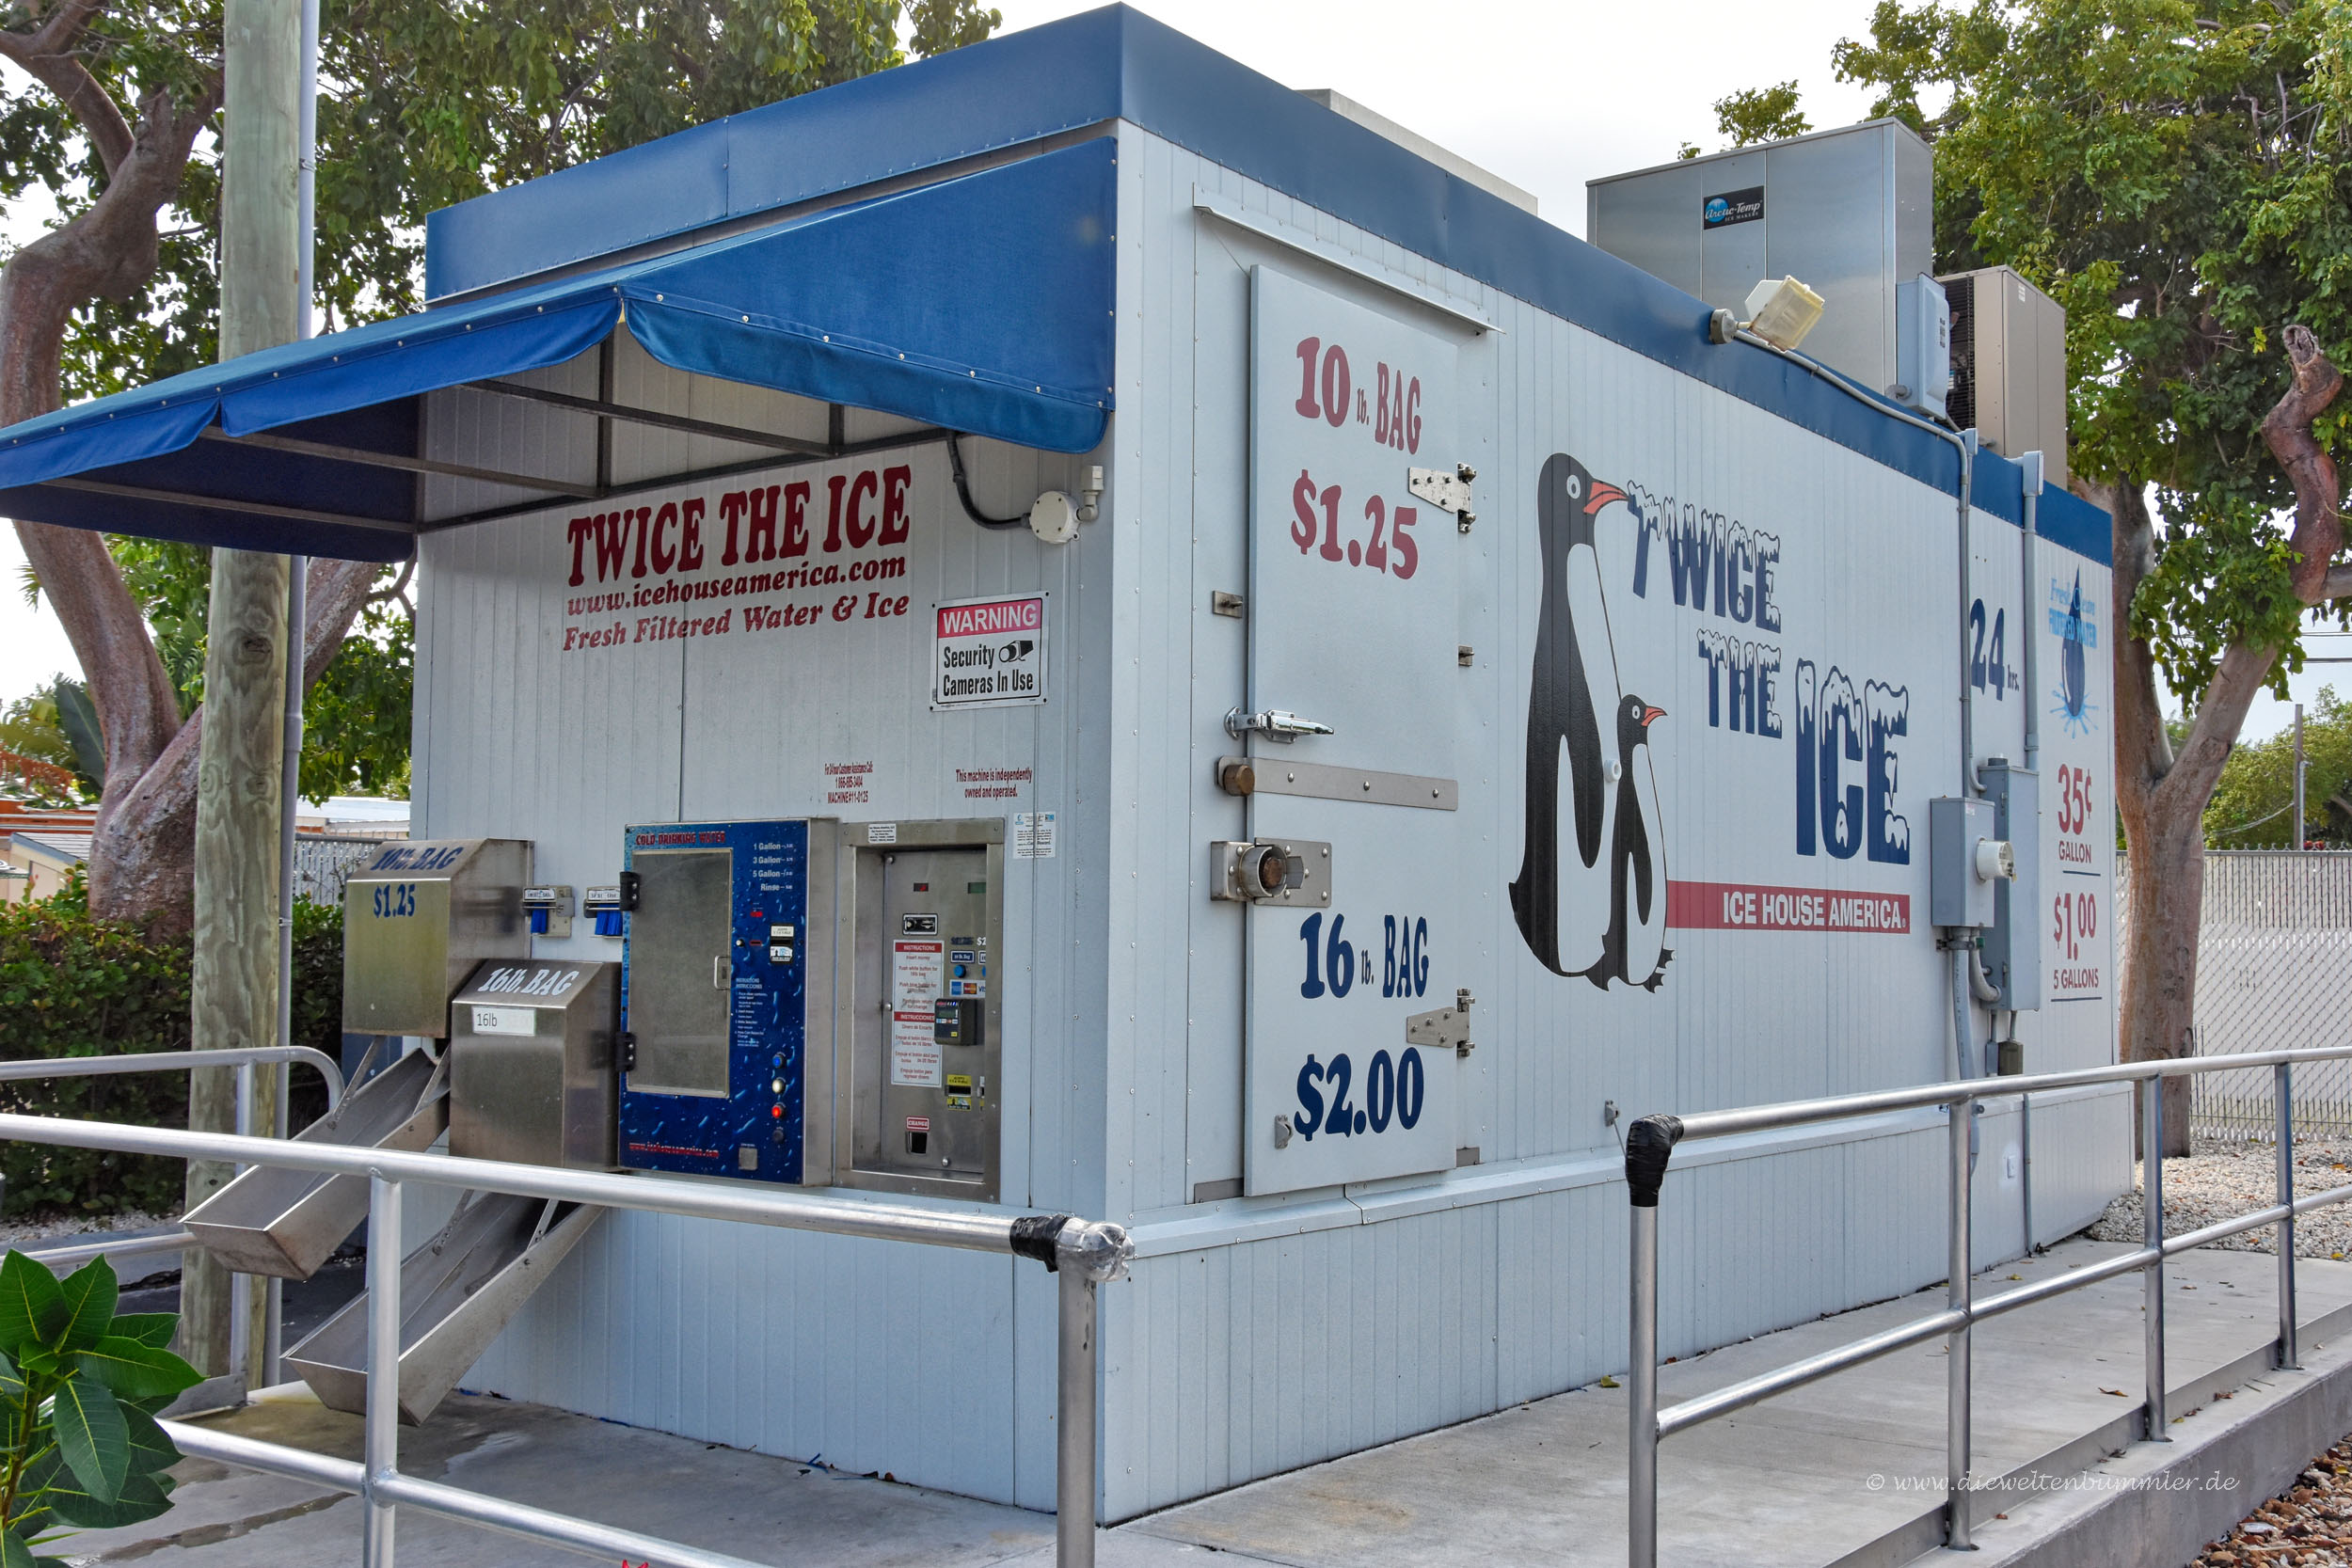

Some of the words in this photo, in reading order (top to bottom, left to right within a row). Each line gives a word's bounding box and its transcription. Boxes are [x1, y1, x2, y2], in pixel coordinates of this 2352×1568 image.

[1295, 336, 1351, 428] 10
[1357, 388, 1370, 426] lb.
[1375, 361, 1422, 455] BAG
[567, 497, 706, 588] TWICE
[719, 480, 810, 566] THE
[822, 464, 912, 553] ICE
[1291, 468, 1419, 579] $1.25
[1627, 480, 1782, 634] TWICE
[566, 556, 907, 616] www.icehouseamerica.com
[563, 623, 627, 651] Fresh
[633, 608, 732, 643] Filtered
[742, 601, 823, 632] Water
[832, 595, 858, 622] &
[863, 592, 911, 619] Ice
[943, 603, 1038, 634] WARNING
[944, 643, 995, 670] Security
[1970, 598, 2005, 702] 24
[943, 674, 993, 697] Cameras
[997, 670, 1009, 692] In
[1012, 669, 1034, 691] Use
[1696, 628, 1783, 739] THE
[956, 768, 967, 783] This
[967, 768, 989, 782] machine
[990, 768, 994, 782] is
[995, 767, 1032, 784] independently
[1795, 657, 1911, 865] ICE
[964, 784, 981, 799] owned
[982, 784, 992, 798] and
[636, 833, 656, 846] COLD
[658, 832, 696, 845] DRINKING
[758, 842, 781, 851] Gallon
[2058, 840, 2092, 863] GALLON
[407, 847, 464, 870] BAG
[753, 856, 757, 864] 3
[758, 856, 781, 864] Gallon
[758, 869, 781, 878] Gallon
[373, 883, 416, 918] $1.25
[760, 883, 780, 892] Rinse
[1724, 892, 1756, 925] ICE
[1762, 894, 1825, 927] HOUSE
[2054, 892, 2097, 961] $1.00
[1300, 911, 1355, 999] 16
[1361, 949, 1375, 986] lb.
[1382, 914, 1430, 999] BAG
[520, 969, 580, 996] BAG
[2053, 969, 2058, 989] 5
[2061, 968, 2099, 989] GALLONS
[477, 1013, 498, 1027] 16lb
[1294, 1046, 1424, 1142] $2.00
